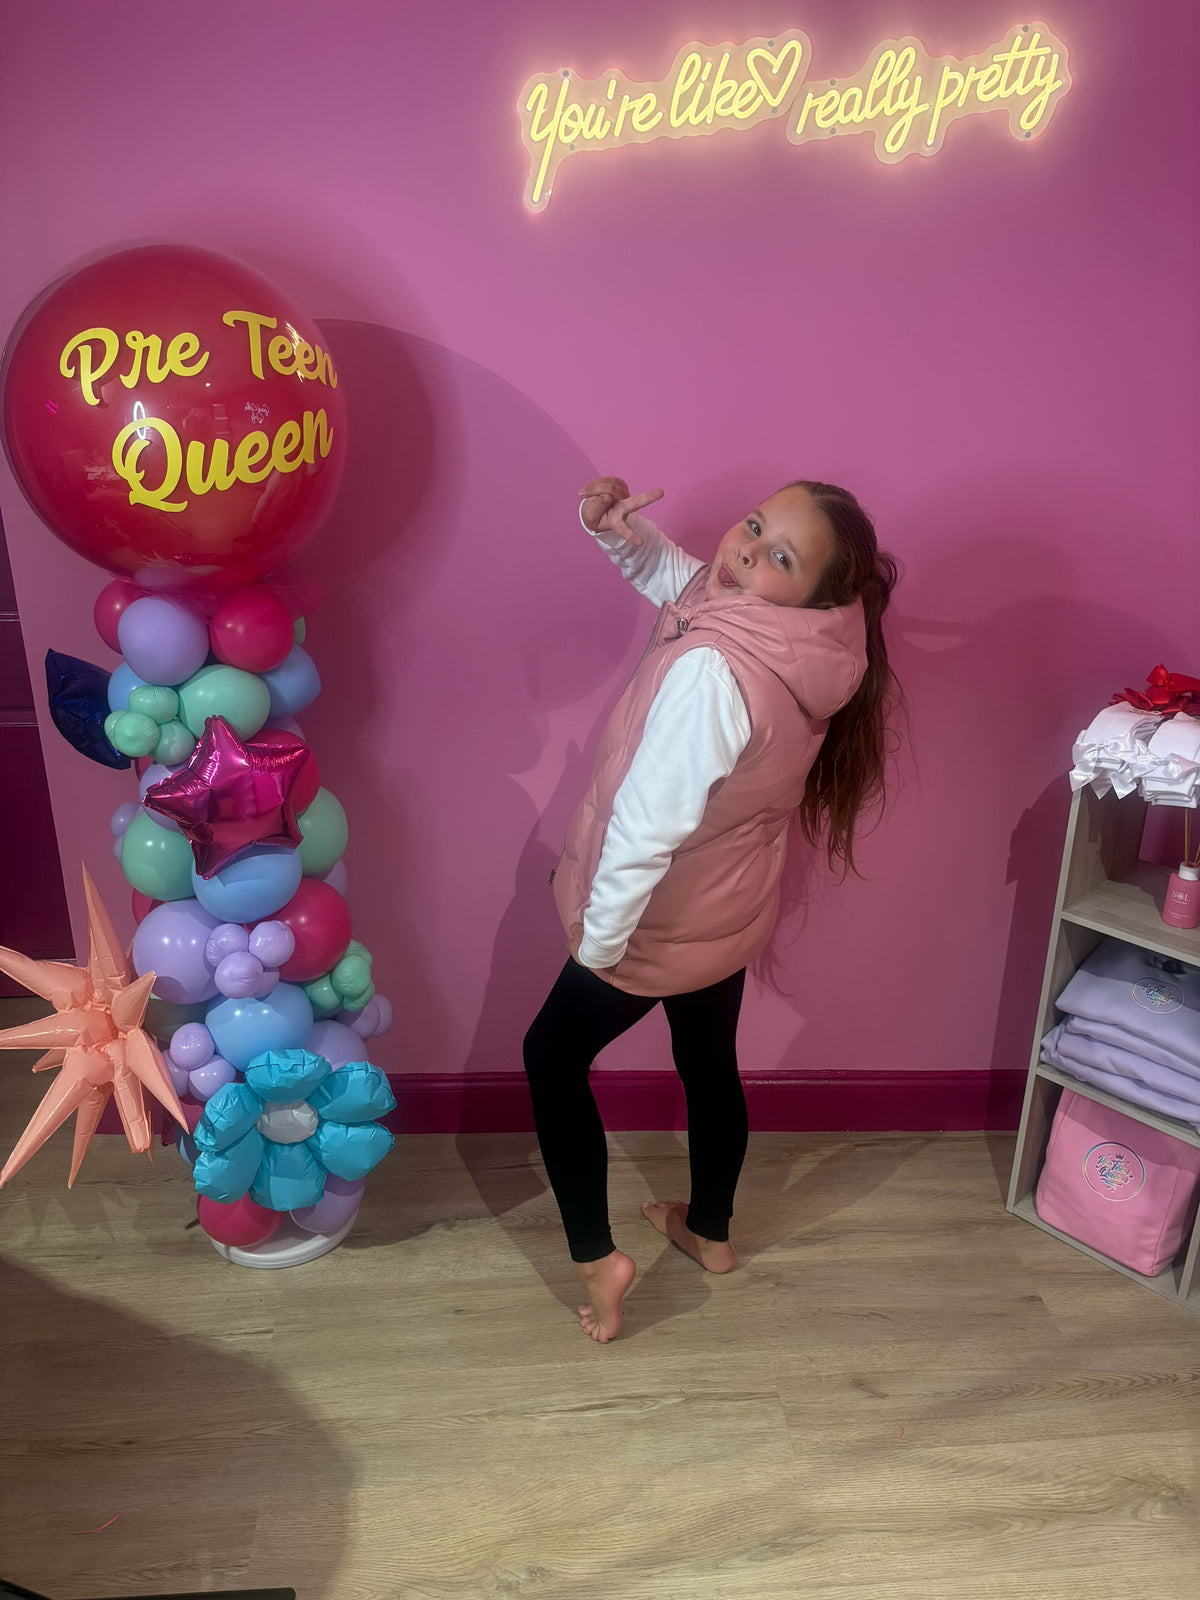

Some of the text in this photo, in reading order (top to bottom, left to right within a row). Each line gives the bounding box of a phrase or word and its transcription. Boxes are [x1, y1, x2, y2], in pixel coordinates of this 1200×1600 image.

[526, 32, 1062, 203] You're like really pretty
[59, 310, 338, 406] Pre Teen
[111, 408, 334, 513] Queen
